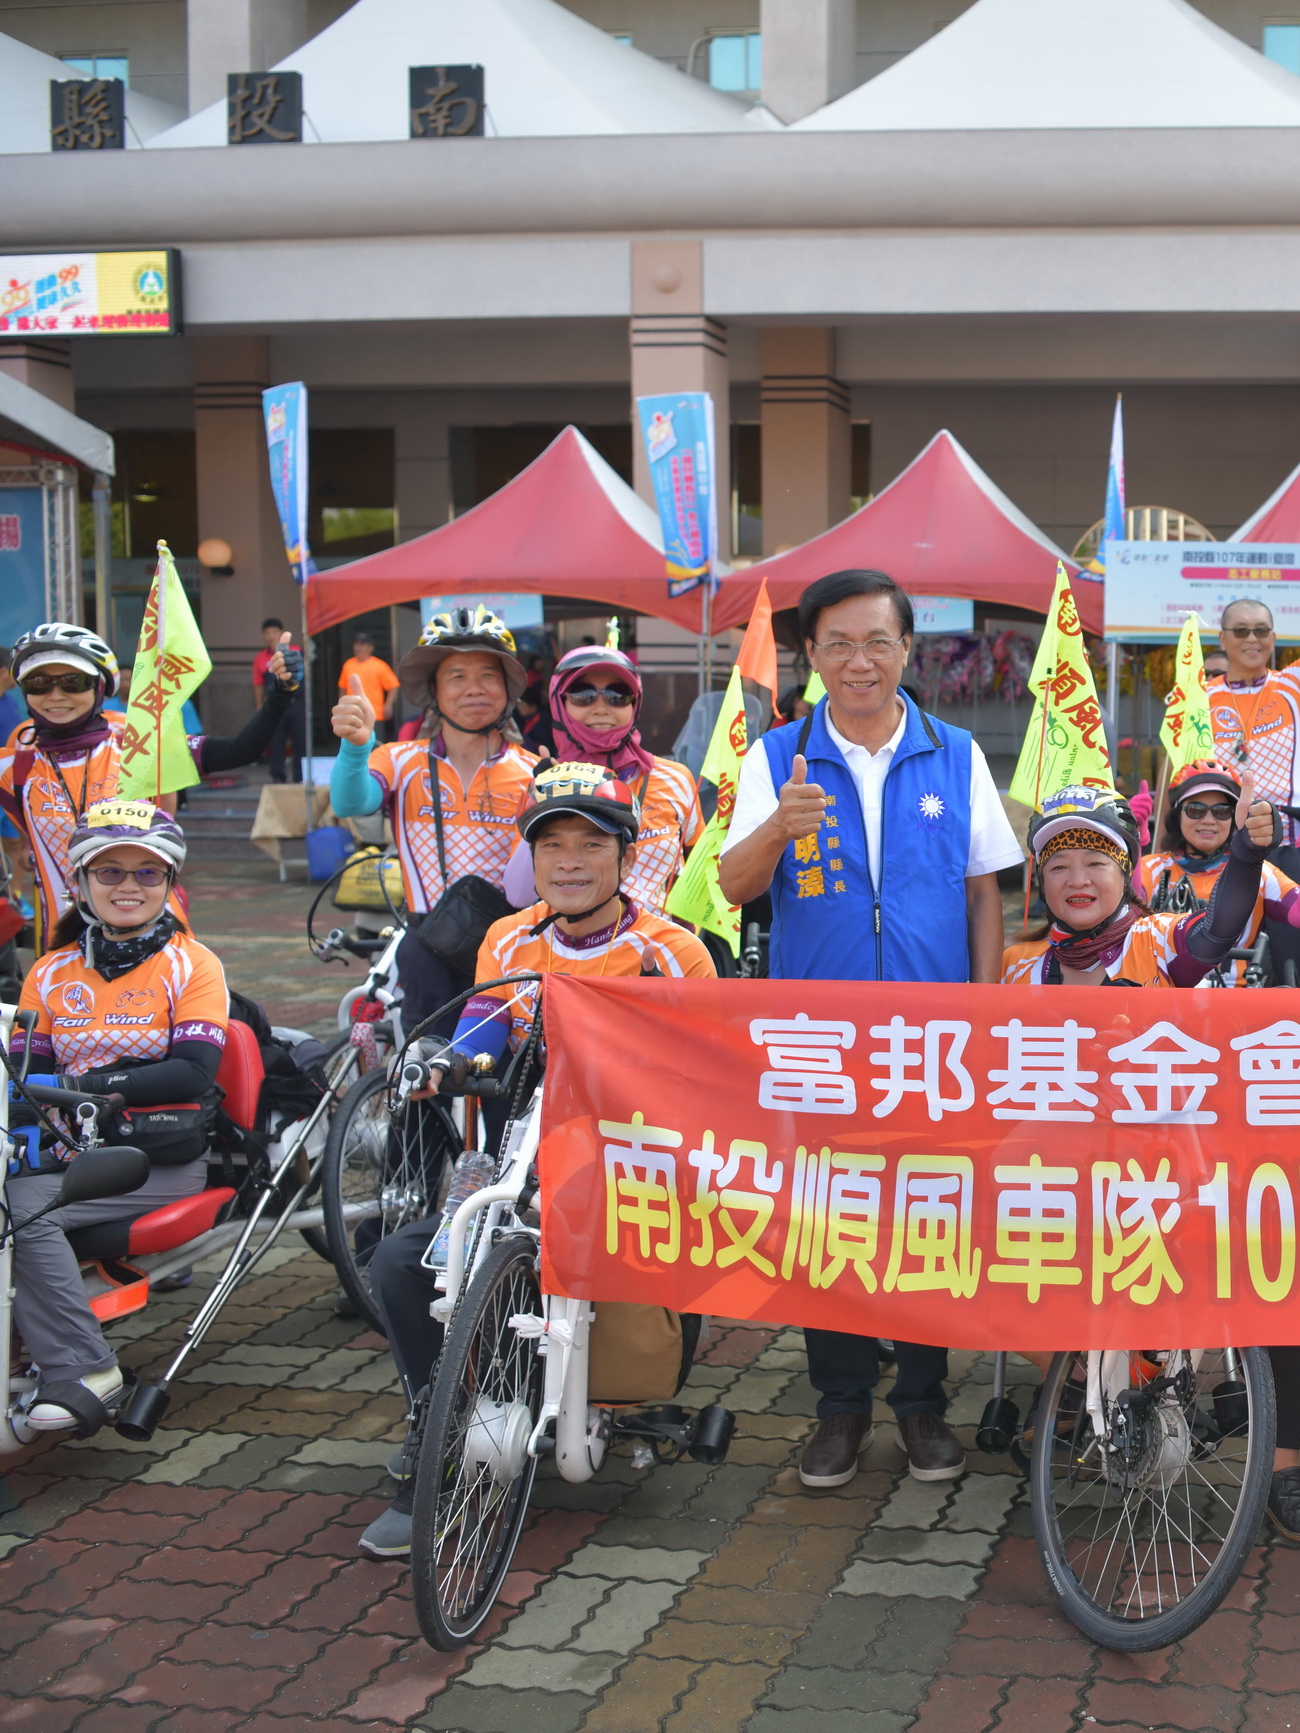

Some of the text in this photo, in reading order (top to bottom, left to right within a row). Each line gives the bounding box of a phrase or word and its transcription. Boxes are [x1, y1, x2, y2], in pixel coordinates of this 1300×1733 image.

[51, 66, 480, 150] 南 投 縣
[1252, 714, 1283, 735] Wind
[100, 807, 148, 818] 0150
[467, 810, 517, 825] Wind
[825, 795, 847, 893] 南投縣縣長
[53, 1013, 156, 1028] Fair Wind
